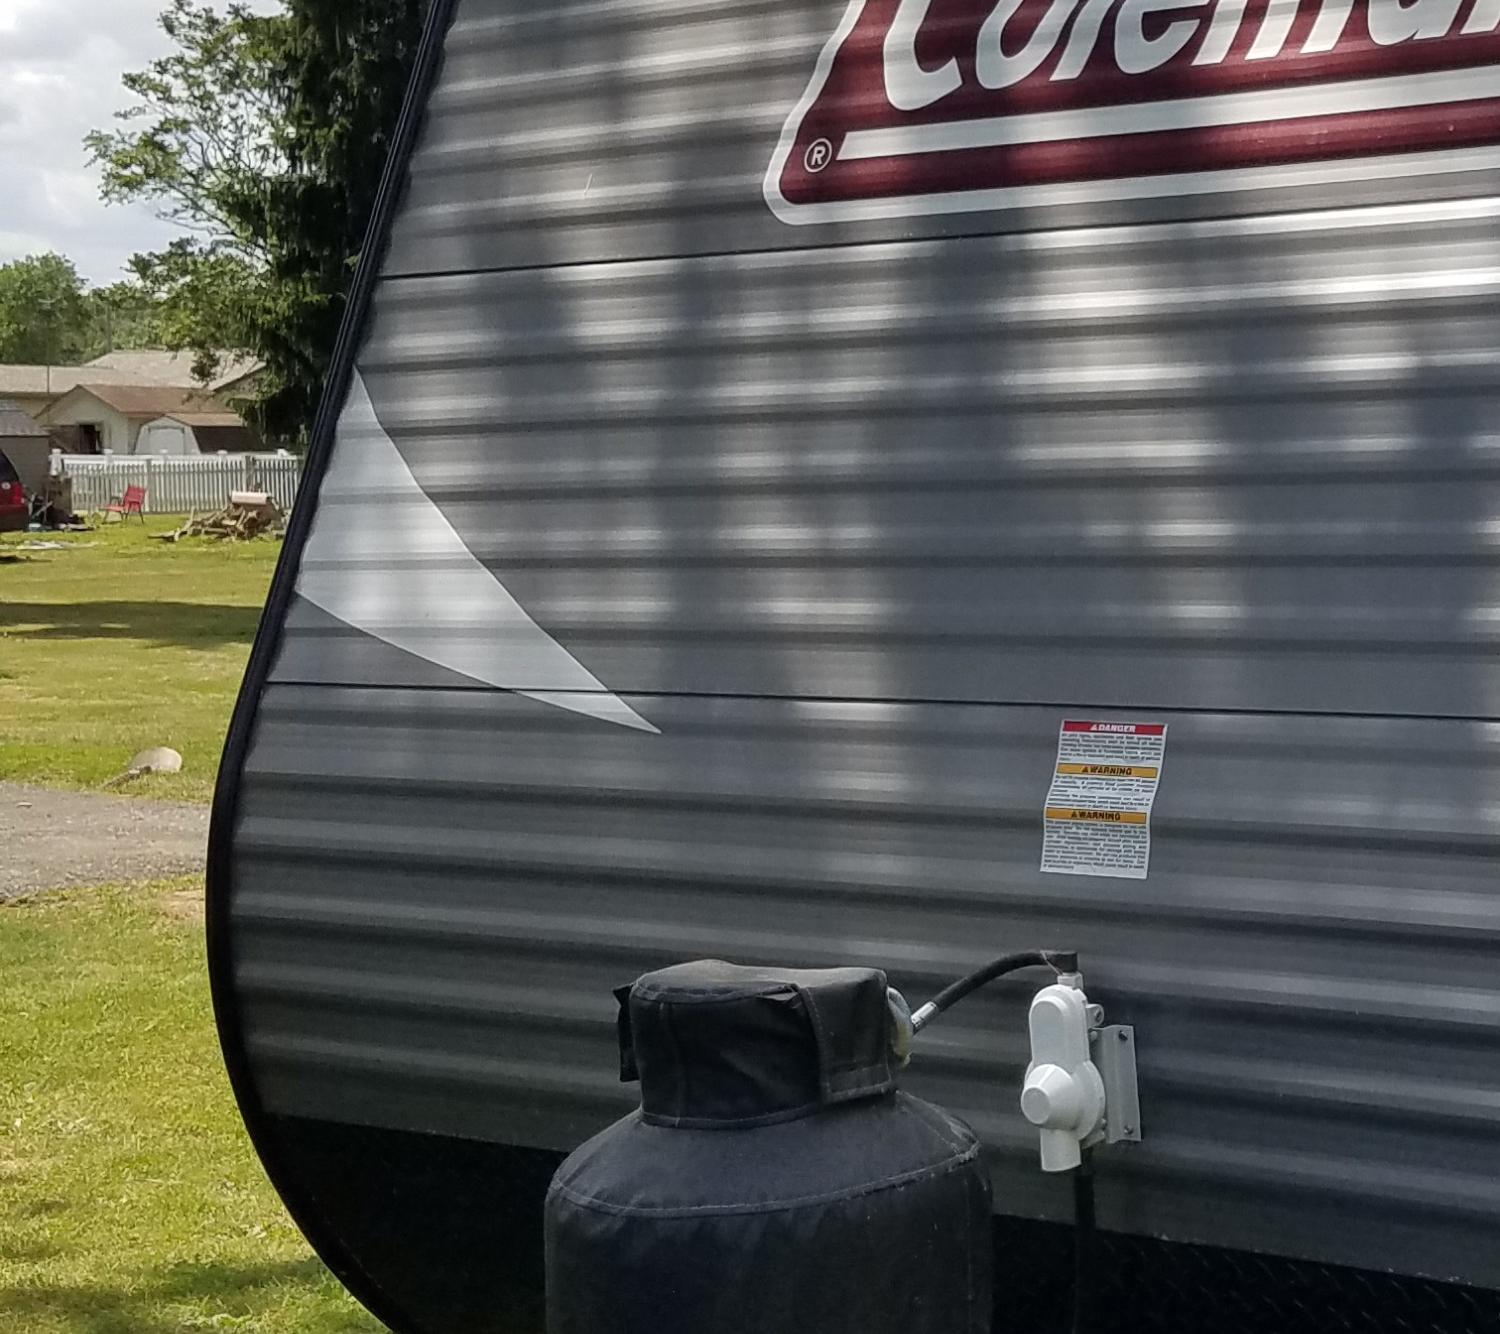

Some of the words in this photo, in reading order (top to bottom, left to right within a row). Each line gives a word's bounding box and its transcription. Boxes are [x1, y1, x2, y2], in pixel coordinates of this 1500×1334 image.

[1097, 724, 1137, 733] DANGER
[1089, 766, 1133, 775] WARNING
[1077, 811, 1121, 821] WARNING
